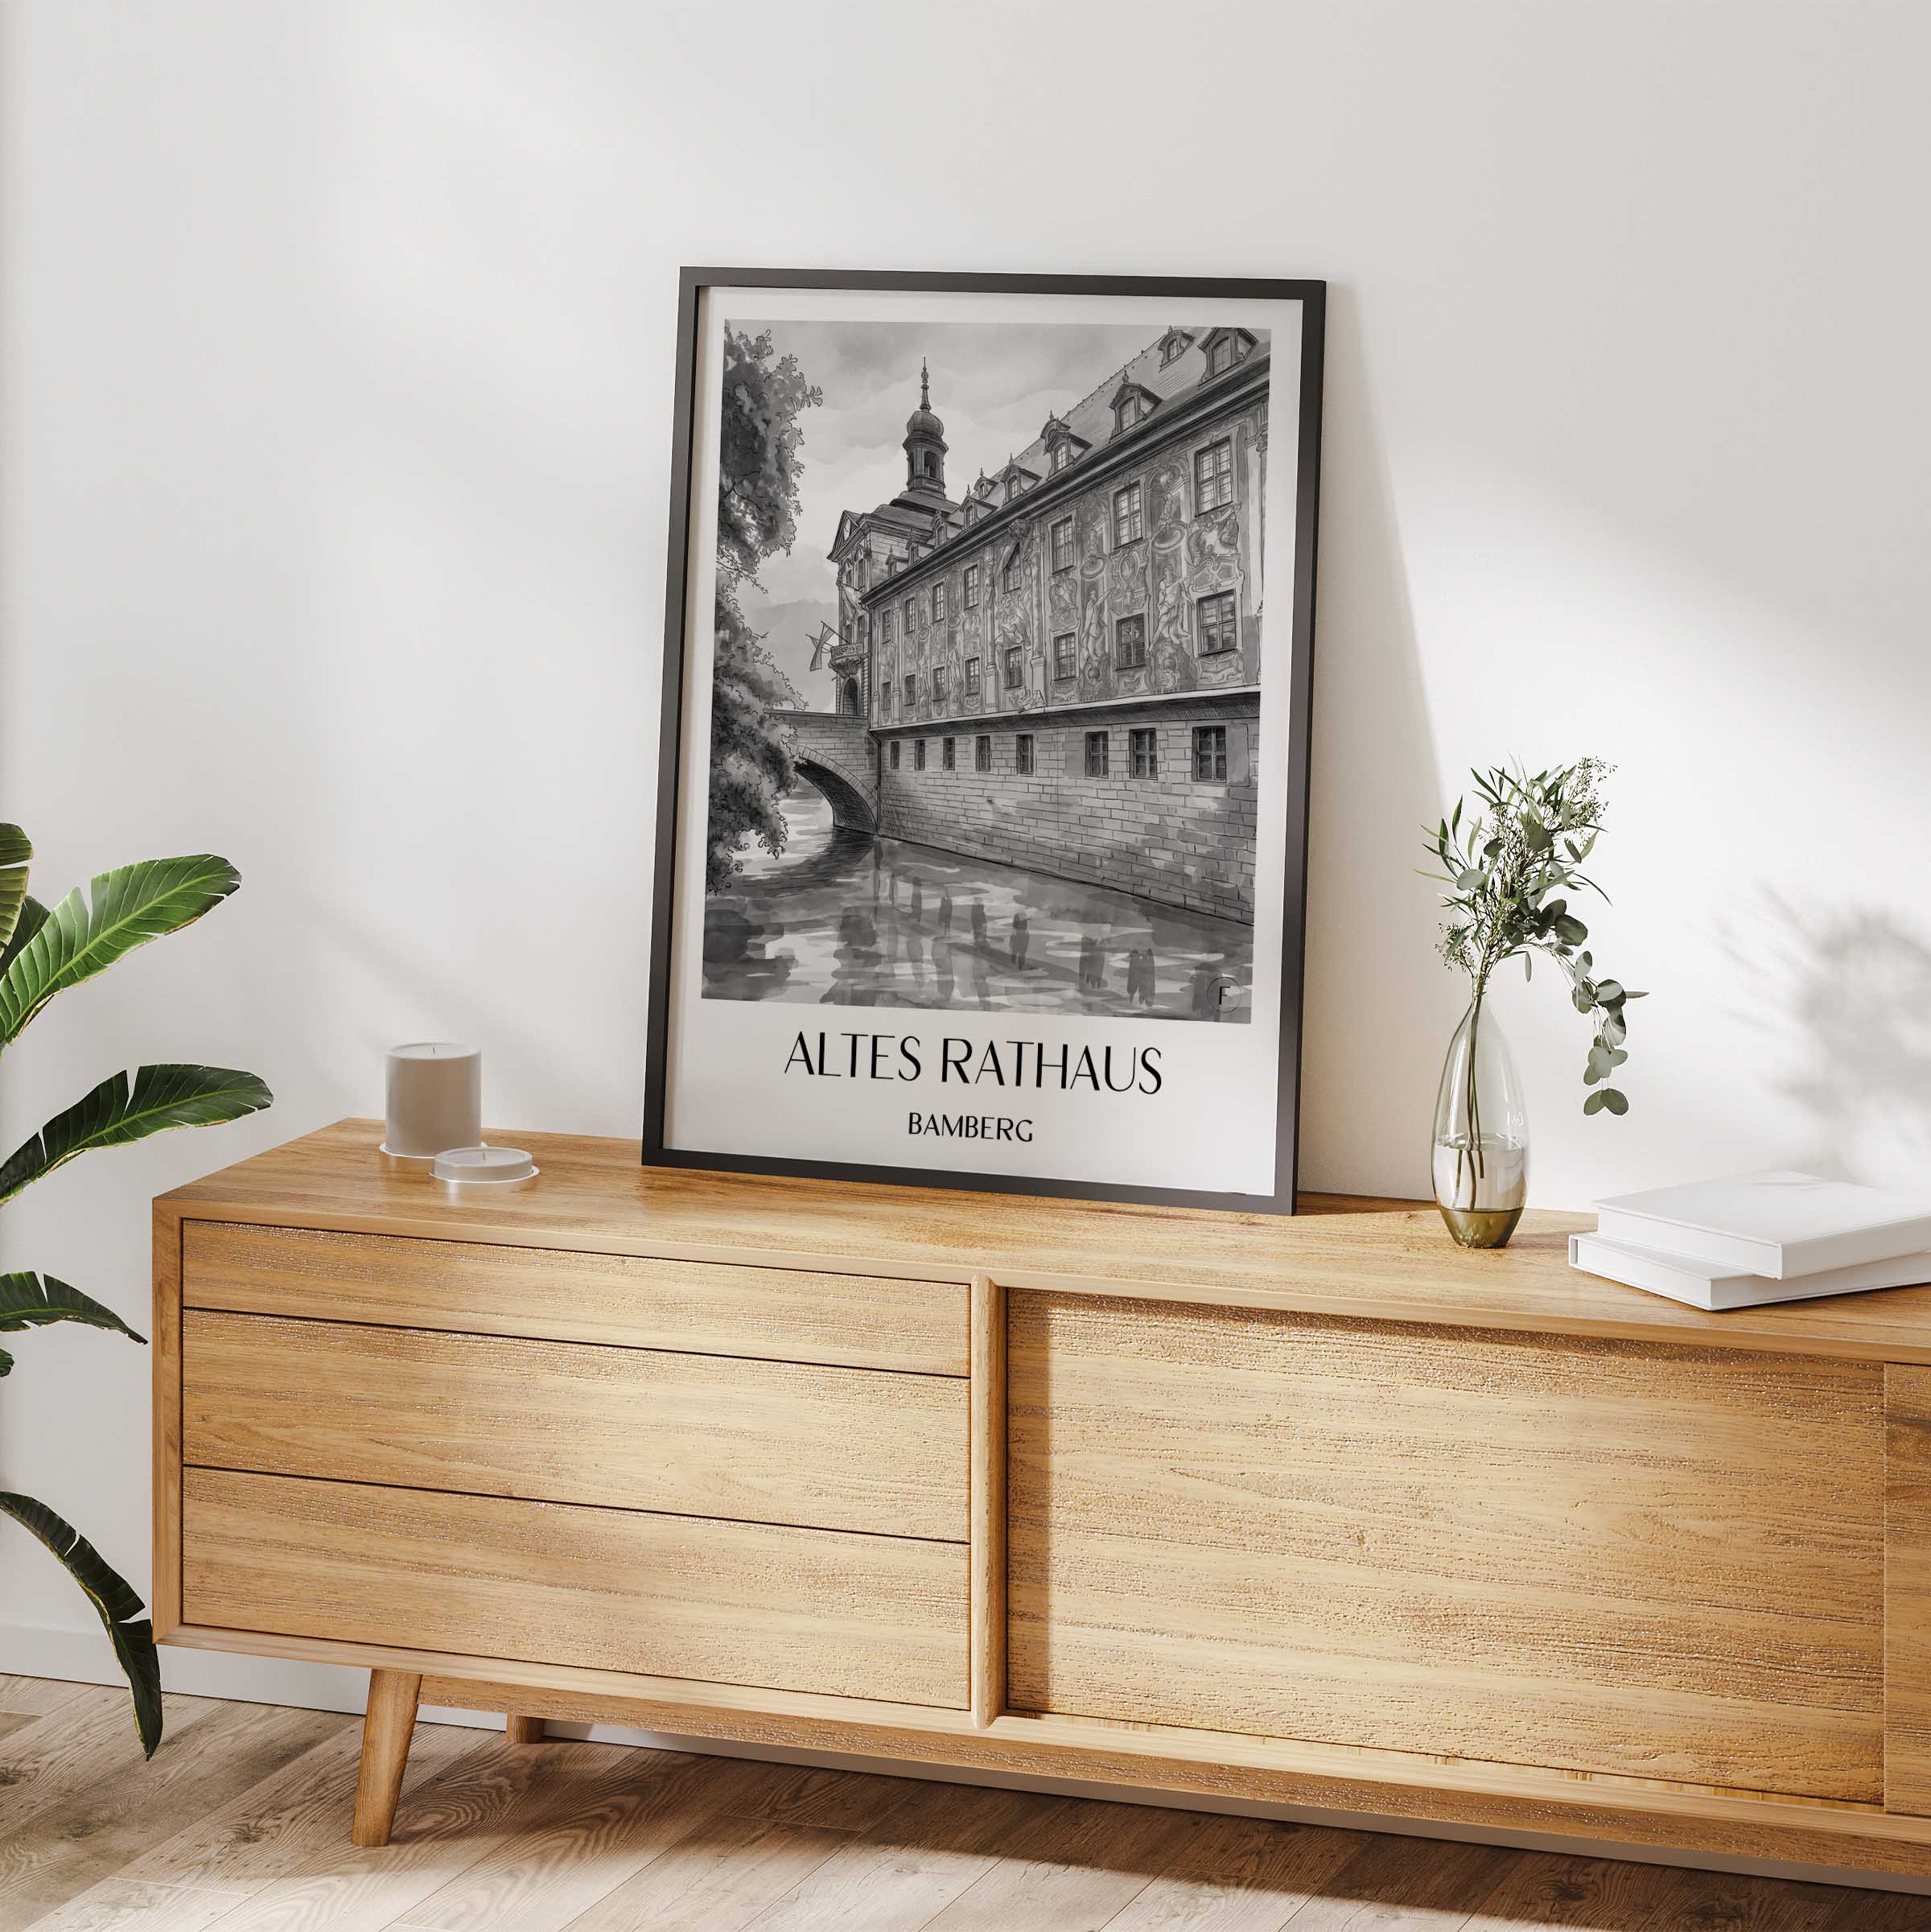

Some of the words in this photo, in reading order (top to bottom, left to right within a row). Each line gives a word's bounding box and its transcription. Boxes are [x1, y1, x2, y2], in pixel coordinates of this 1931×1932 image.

[1218, 985, 1231, 1005] F
[783, 1031, 921, 1082] ALTES
[941, 1037, 1163, 1095] RATHAUS
[908, 1112, 1033, 1143] BAMBERG
